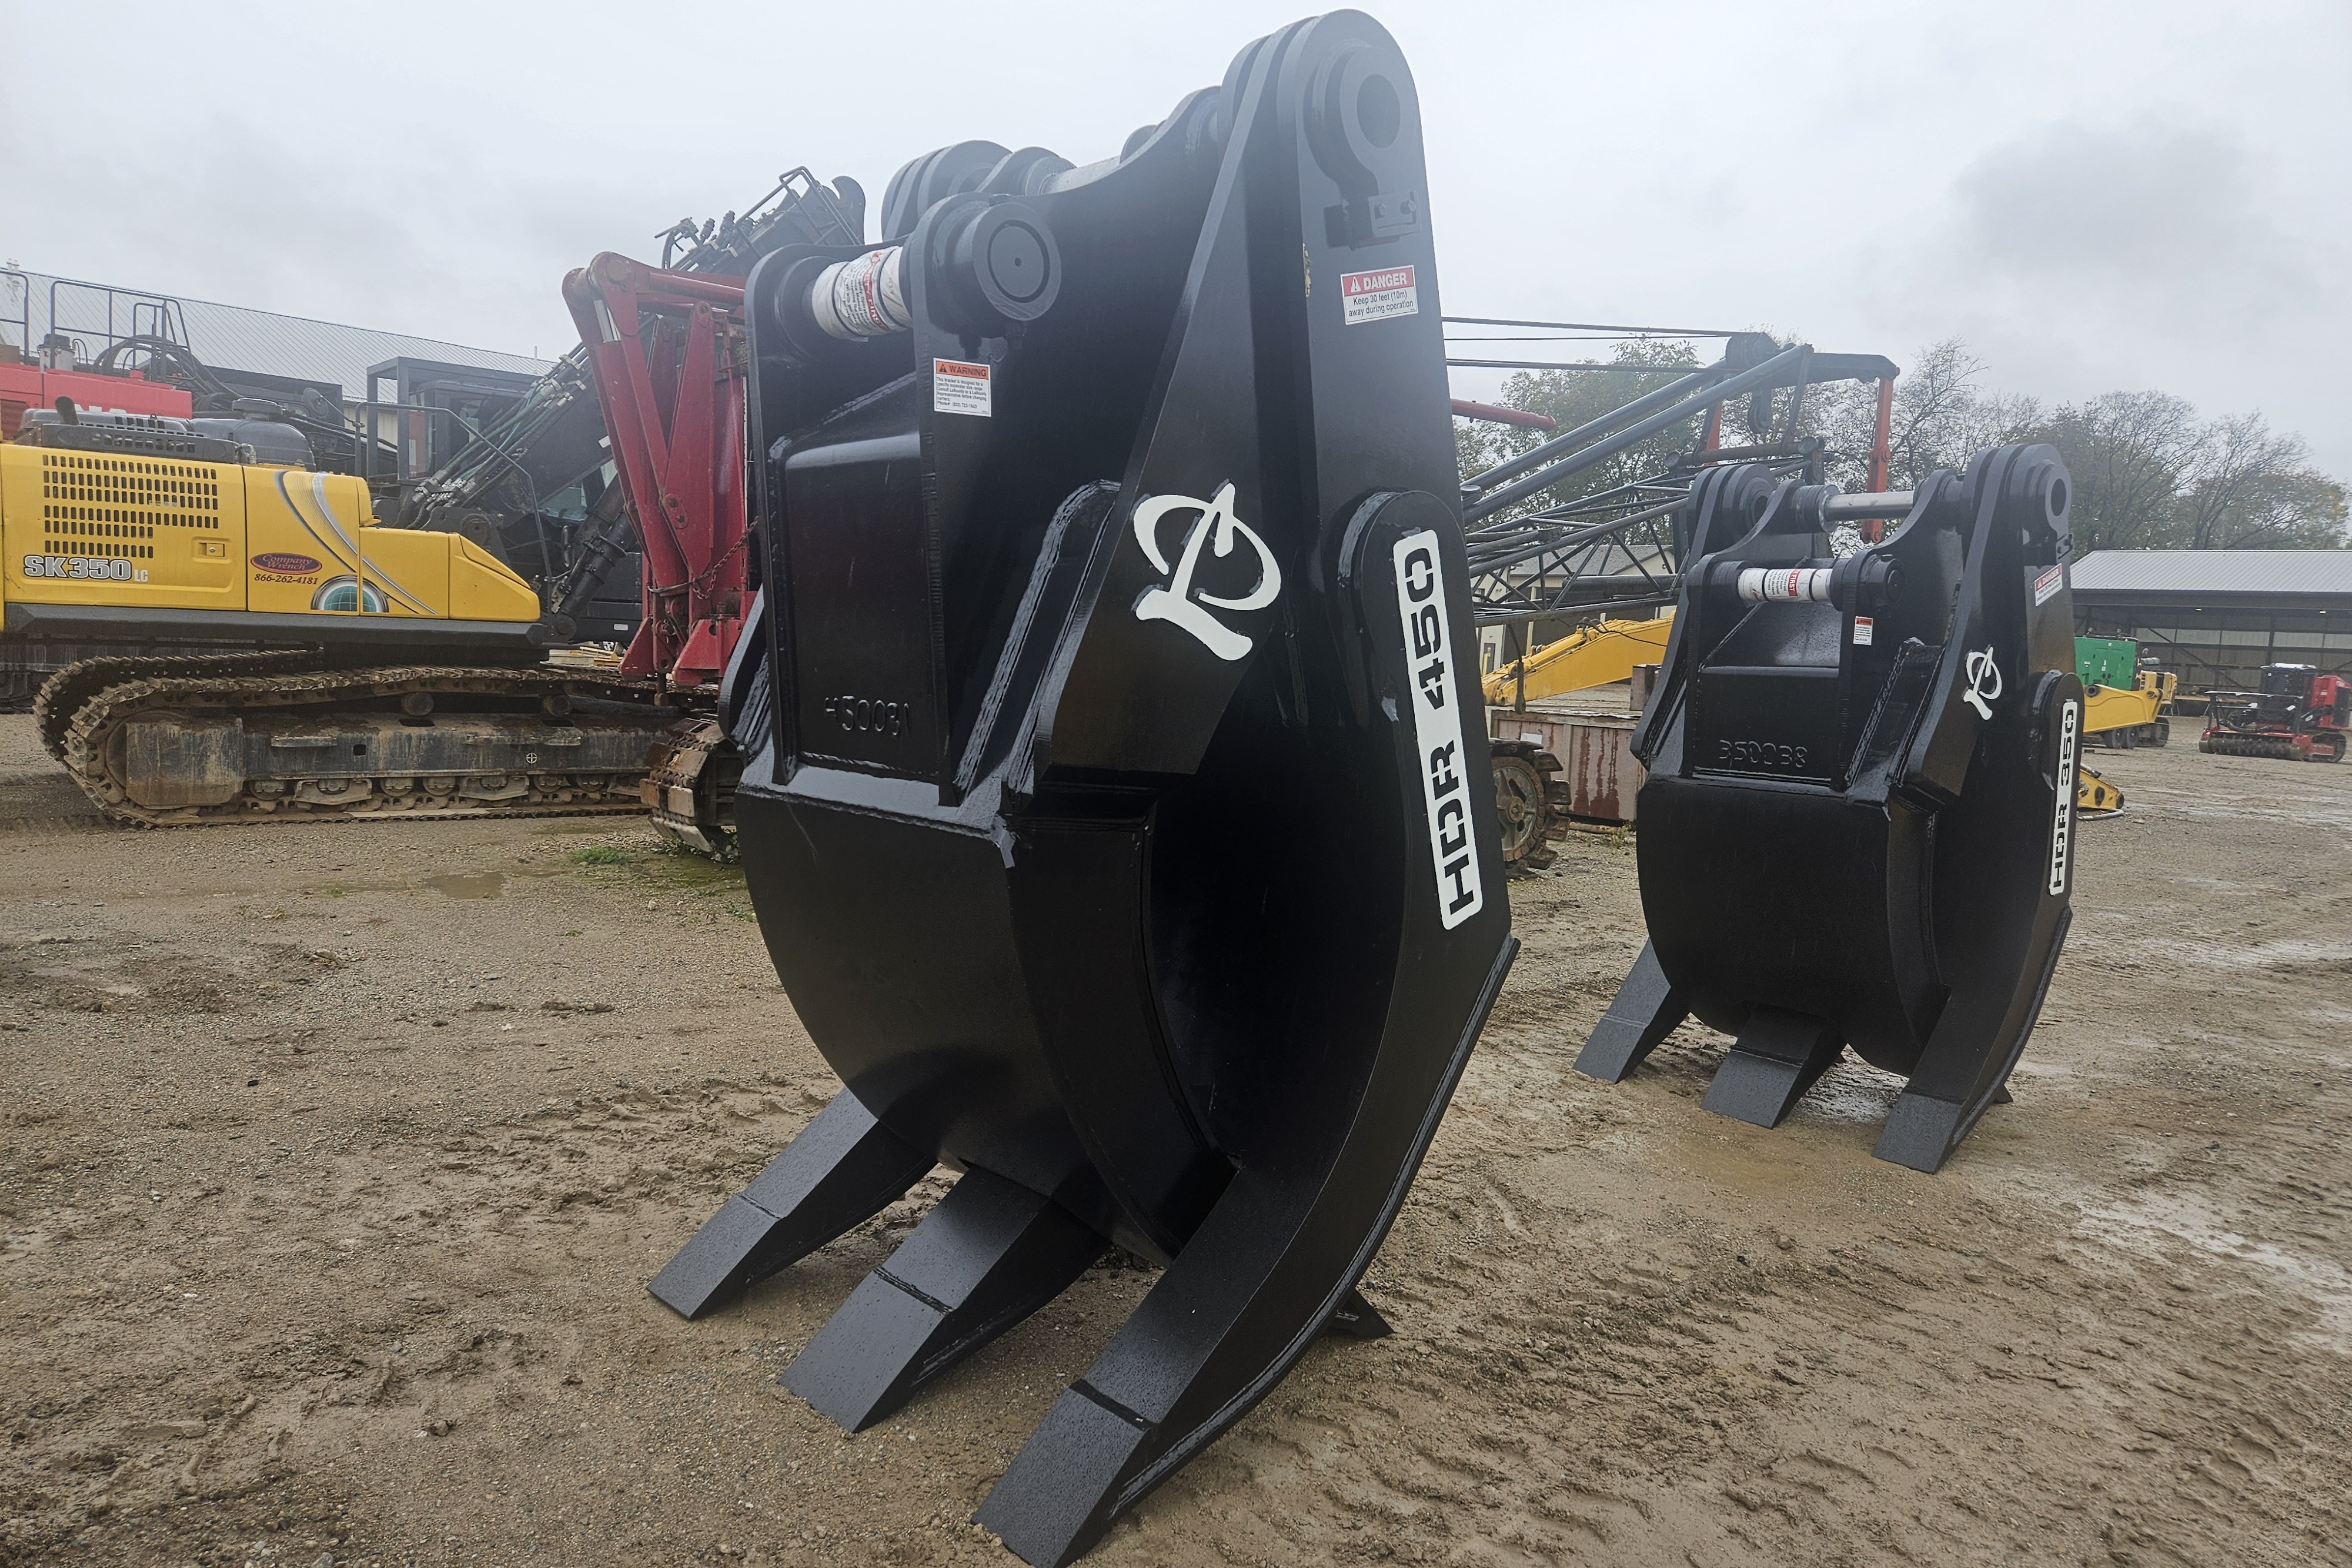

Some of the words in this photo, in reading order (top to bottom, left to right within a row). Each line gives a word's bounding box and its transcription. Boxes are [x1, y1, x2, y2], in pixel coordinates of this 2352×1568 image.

[1363, 272, 1407, 290] DANGER
[1353, 297, 1369, 306] Keep
[1370, 295, 1377, 303] 30
[1378, 293, 1389, 301] feet
[1391, 290, 1407, 302] (10m)
[1349, 309, 1364, 317] away
[1366, 305, 1385, 314] during
[1387, 300, 1413, 312] operation
[949, 365, 987, 376] WARNING
[23, 554, 132, 581] SK350
[262, 554, 312, 566] Company
[267, 561, 306, 570] Wrench
[134, 569, 148, 582] LC
[255, 574, 318, 584] 866-262-4181
[1405, 547, 1446, 710] 450
[1719, 740, 1808, 768] 350038
[2053, 803, 2067, 888] HDR
[2061, 709, 2074, 787] 350
[1431, 740, 1474, 915] HDR
